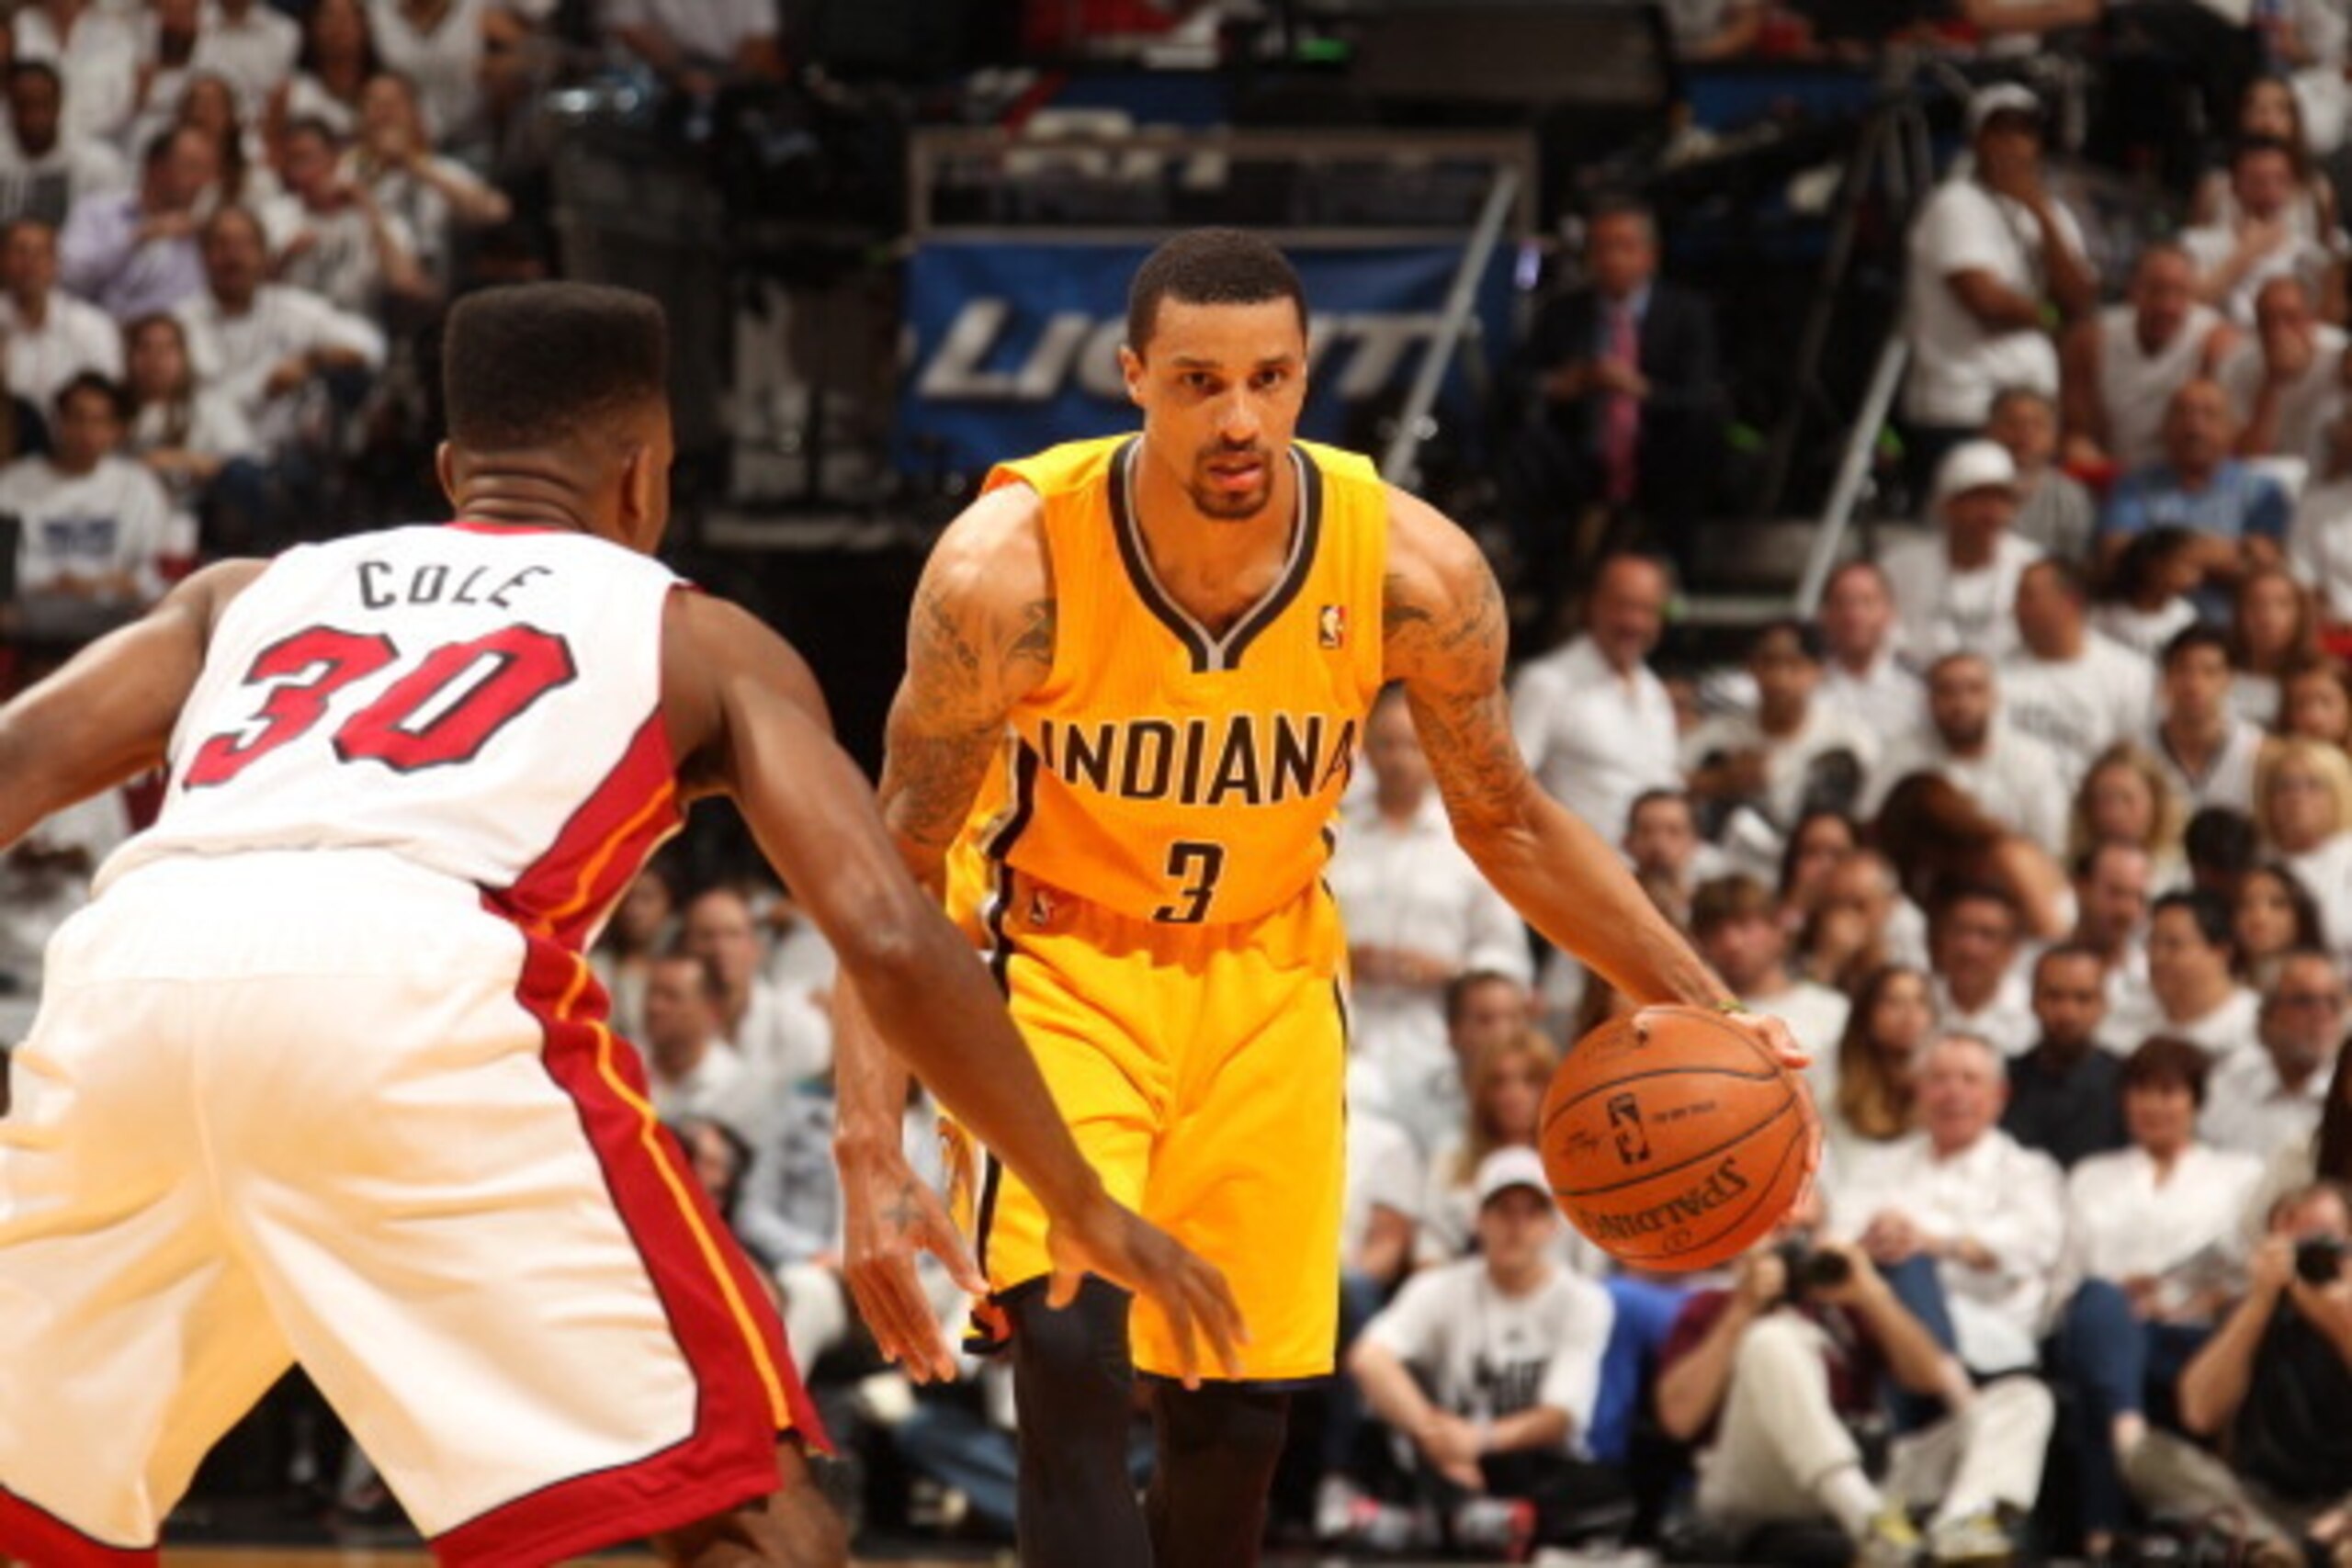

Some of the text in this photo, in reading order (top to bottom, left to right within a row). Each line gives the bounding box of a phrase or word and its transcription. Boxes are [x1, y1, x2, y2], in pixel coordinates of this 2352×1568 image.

[356, 560, 553, 609] COLE
[182, 623, 579, 791] 30
[1039, 713, 1356, 806] INDIANA
[1152, 840, 1226, 924] 3
